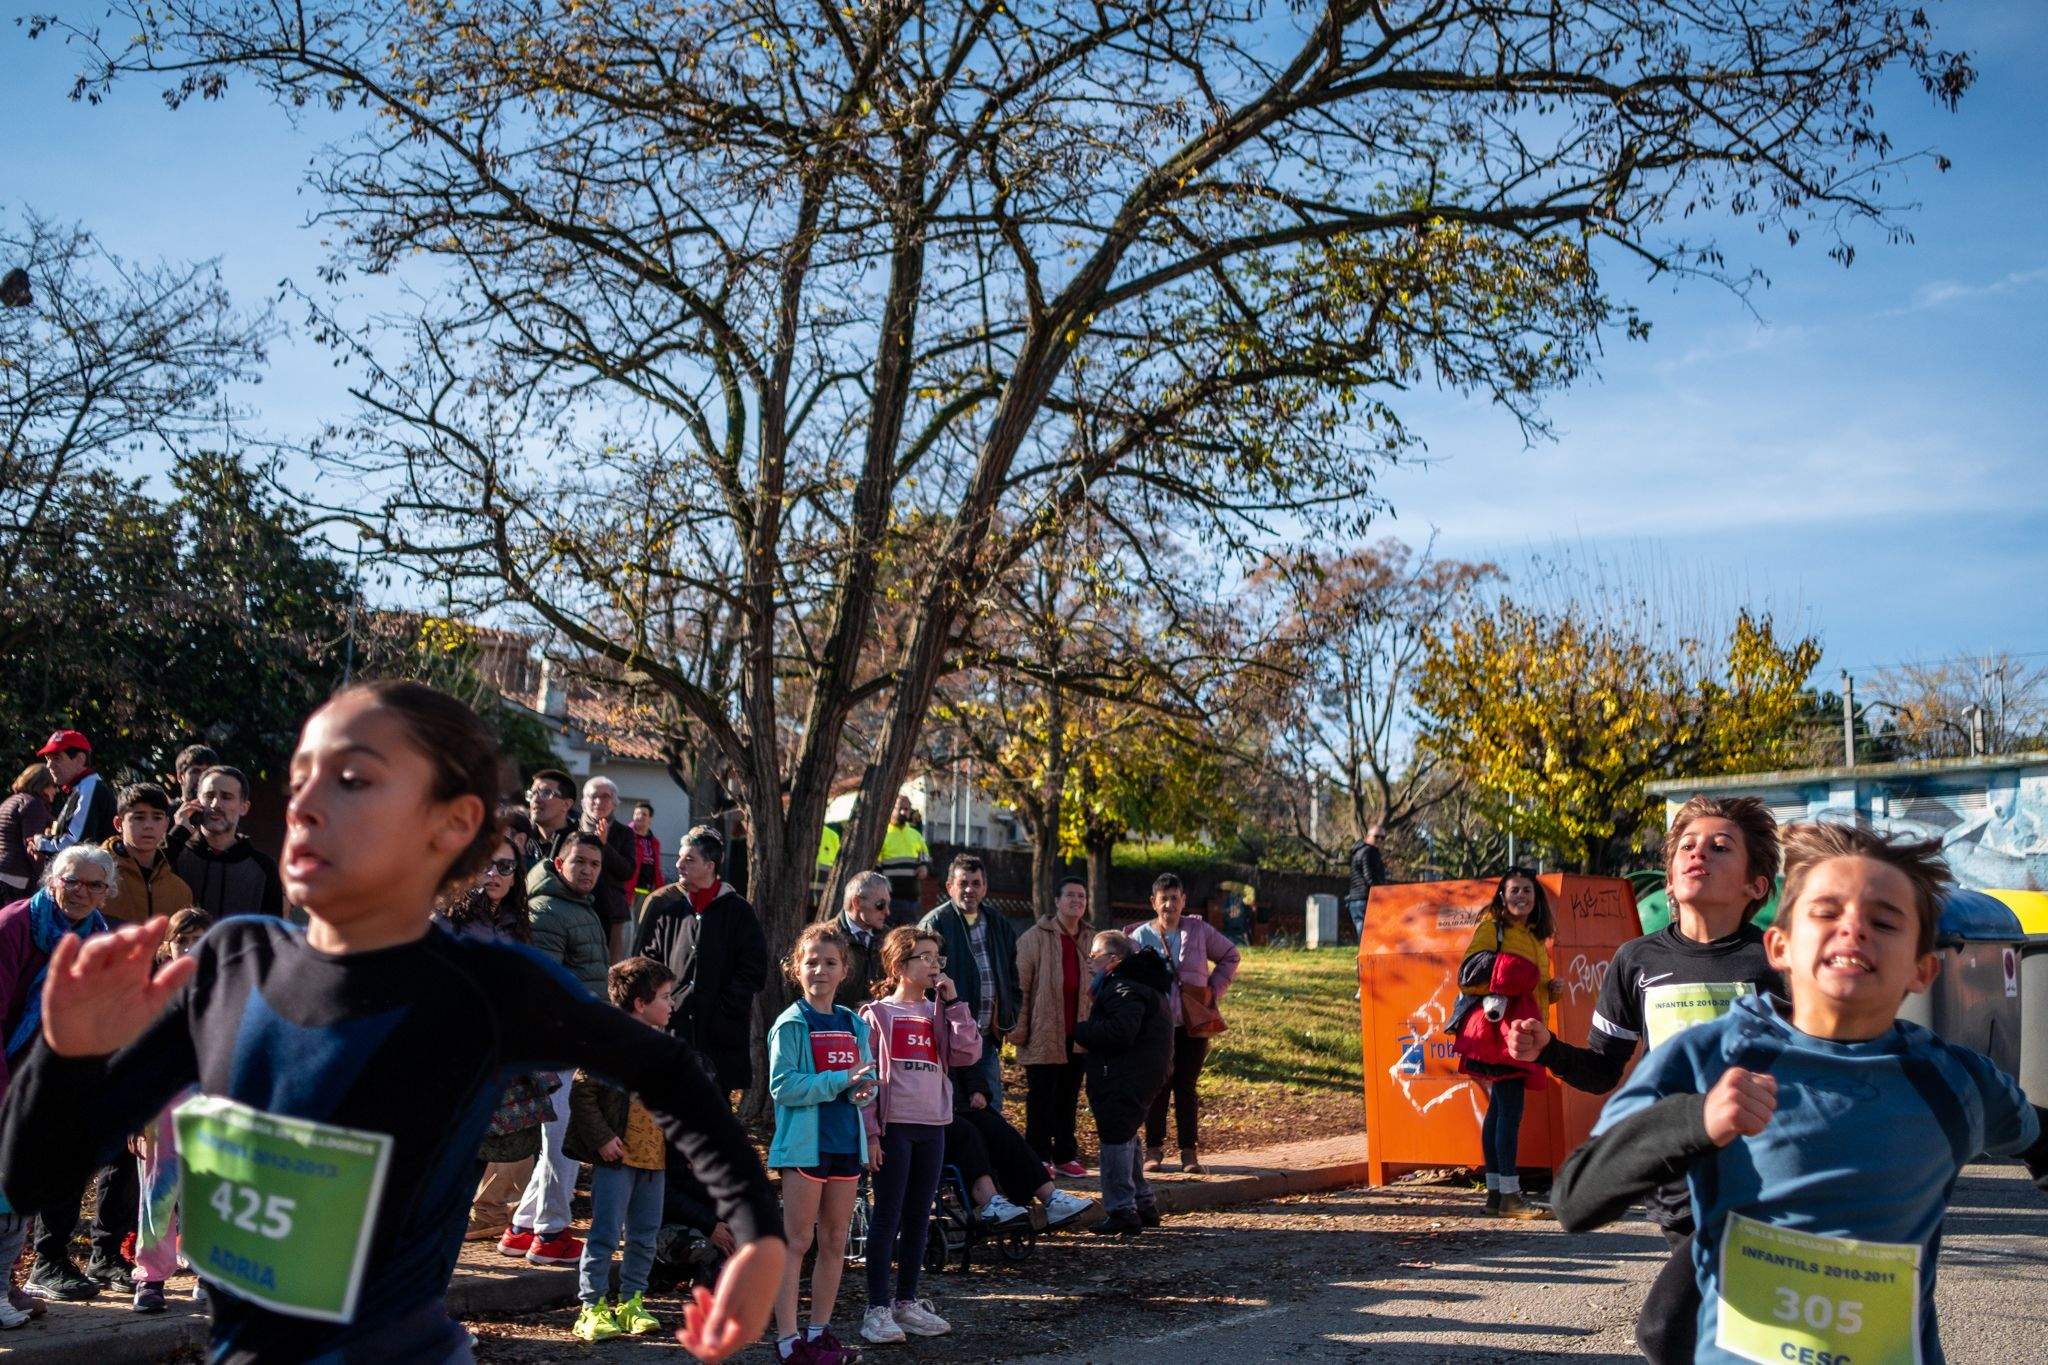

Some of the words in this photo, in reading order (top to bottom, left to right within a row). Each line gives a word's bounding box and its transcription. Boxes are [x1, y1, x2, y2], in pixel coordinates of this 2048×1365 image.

[1656, 1000, 1694, 1009] INFANTILS
[1697, 1000, 1730, 1008] 2010-20
[907, 1034, 931, 1048] 514
[1430, 1041, 1461, 1058] rob
[828, 1051, 854, 1063] 525
[210, 1180, 296, 1240] 425
[1742, 1246, 1819, 1274] INFANTILS
[1824, 1264, 1896, 1284] 2010-2011
[1773, 1286, 1863, 1334] 305
[1780, 1342, 1851, 1365] CESC
